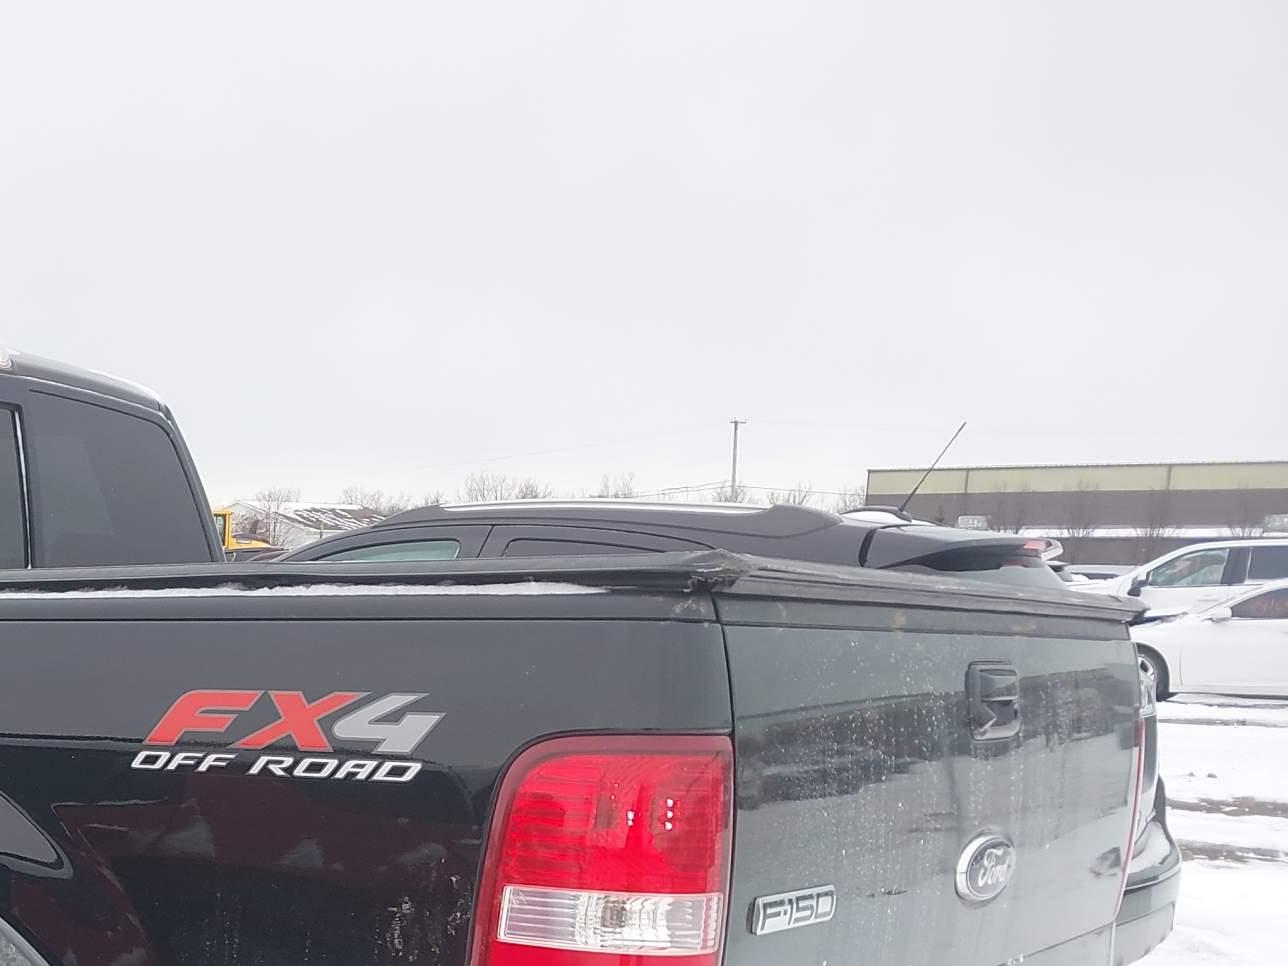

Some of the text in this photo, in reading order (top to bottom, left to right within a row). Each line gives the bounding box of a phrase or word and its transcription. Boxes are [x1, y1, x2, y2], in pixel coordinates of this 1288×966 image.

[143, 689, 447, 754] FX4
[131, 751, 422, 782] OFF ROAD
